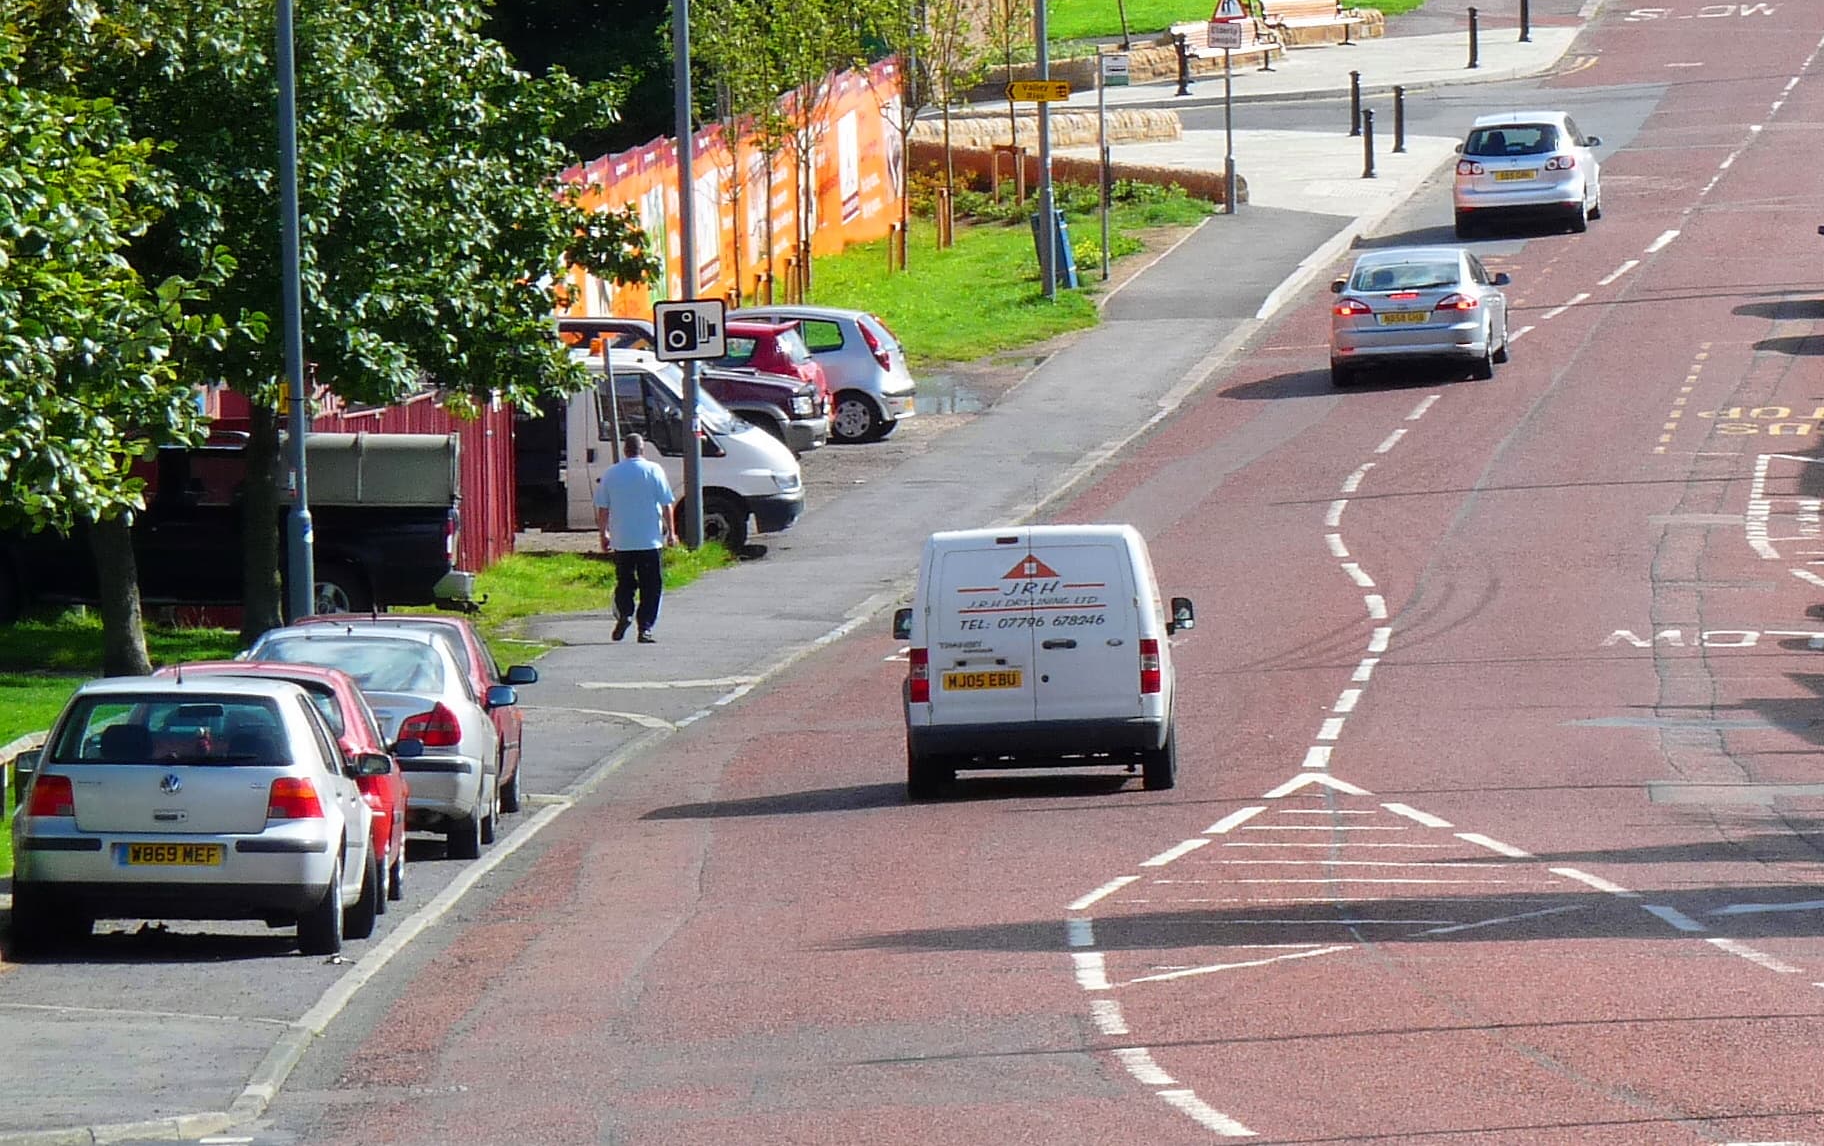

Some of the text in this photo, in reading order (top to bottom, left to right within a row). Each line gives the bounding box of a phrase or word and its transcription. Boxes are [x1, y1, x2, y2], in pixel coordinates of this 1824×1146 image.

[1074, 596, 1098, 604] LTD
[997, 616, 1045, 629] 07796
[1052, 614, 1105, 627] 678246
[989, 671, 1016, 687] EBU
[182, 846, 218, 863] MEF
